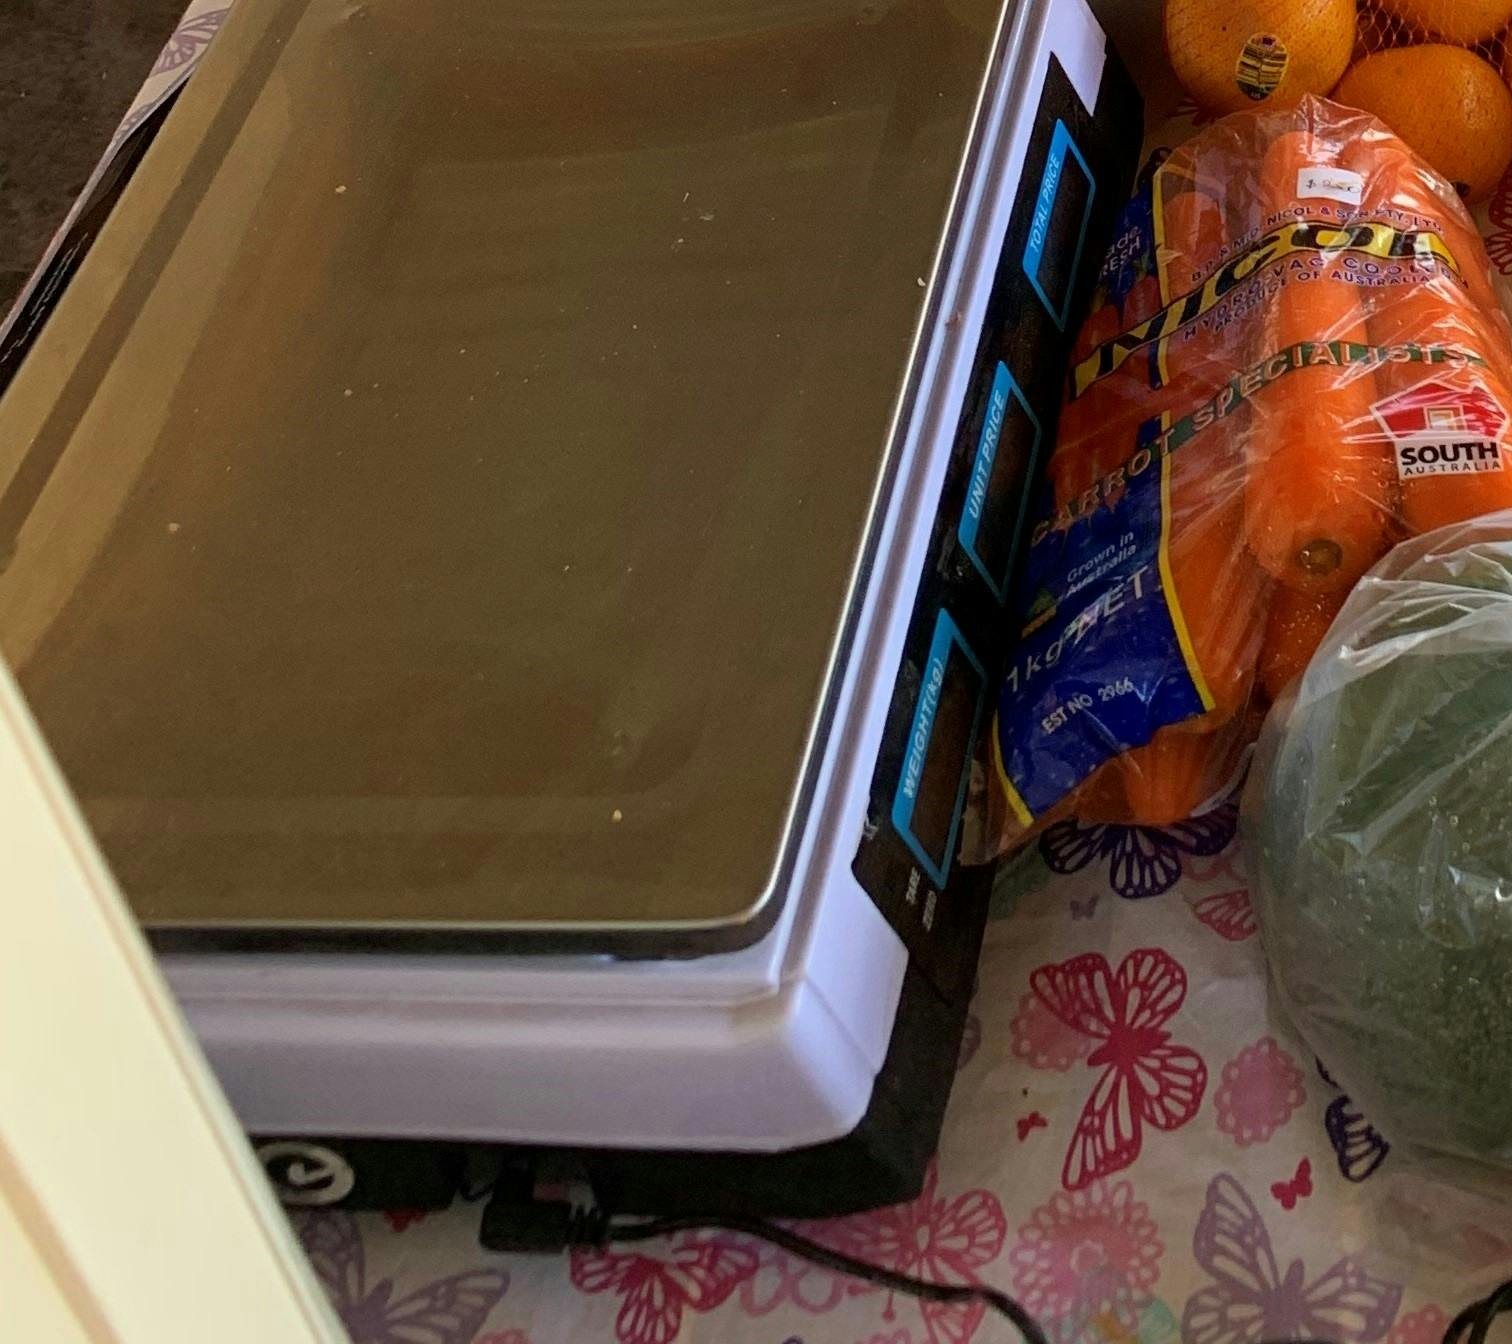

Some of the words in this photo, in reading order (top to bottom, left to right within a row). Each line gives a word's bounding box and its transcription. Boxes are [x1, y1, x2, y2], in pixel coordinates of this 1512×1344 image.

[1029, 203, 1049, 253] TOTAL
[1042, 152, 1061, 202] PRICE
[1266, 206, 1314, 227] NICOL
[1297, 270, 1321, 281] OF
[1191, 340, 1479, 433] SPECIALISTS
[968, 459, 989, 519] UNIT
[981, 388, 1005, 462] PRICE
[1400, 441, 1499, 466] SOUTH
[1403, 460, 1501, 477] AUSTRALIA
[1066, 545, 1116, 583] Grown
[1119, 531, 1135, 548] in
[1066, 542, 1137, 598] Australia
[1041, 705, 1068, 735] EST
[1068, 692, 1094, 715] NO
